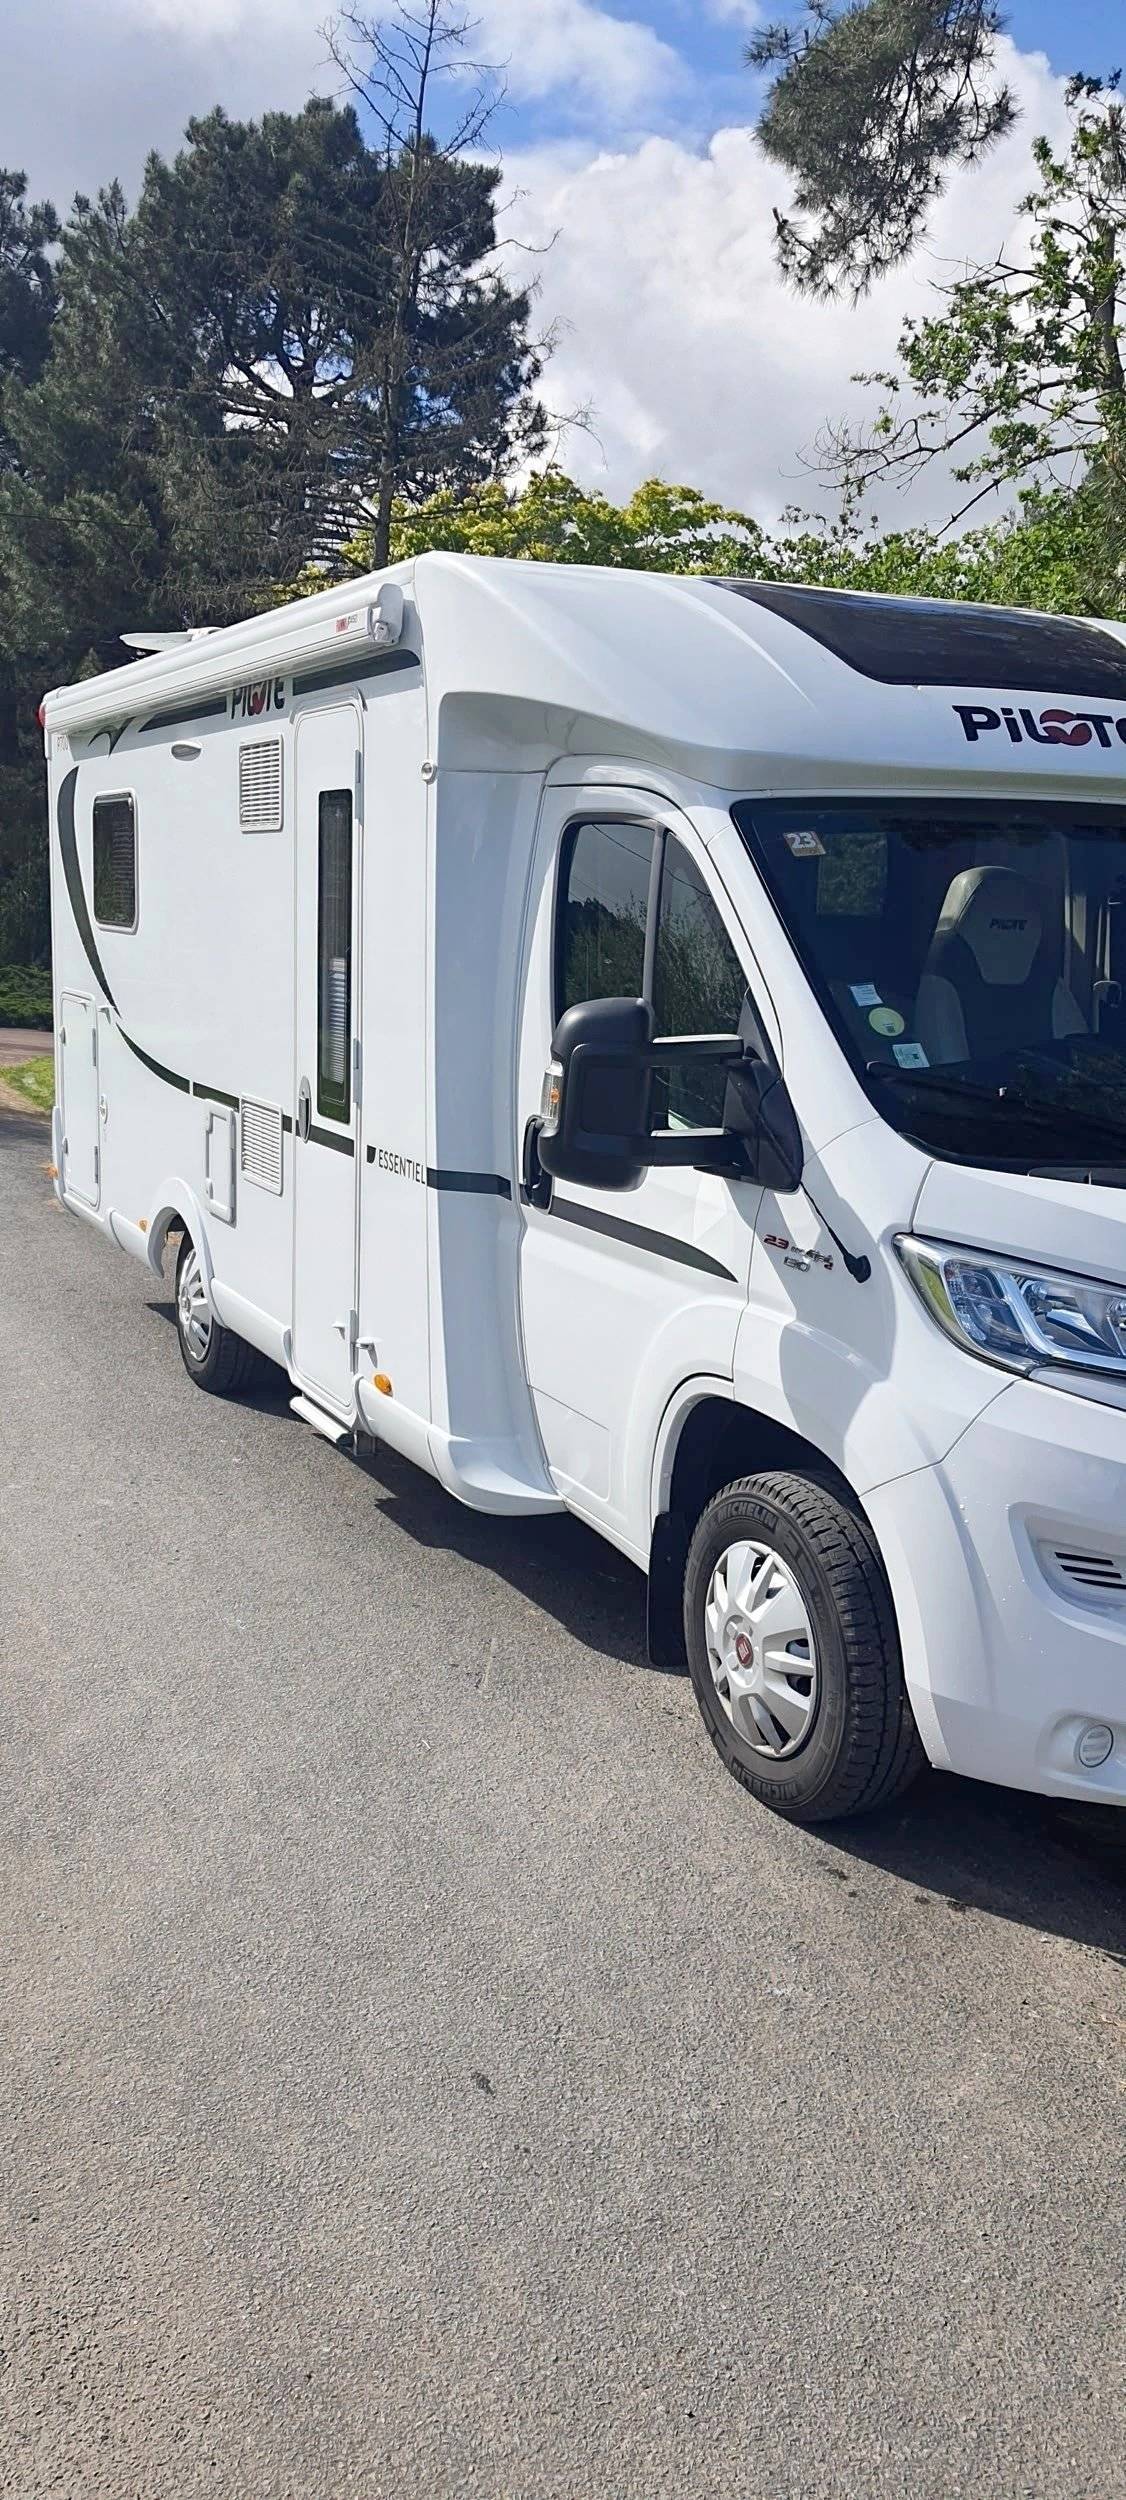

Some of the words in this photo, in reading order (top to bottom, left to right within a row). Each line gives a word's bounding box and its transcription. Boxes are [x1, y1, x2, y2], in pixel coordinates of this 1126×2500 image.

[784, 832, 816, 848] 23
[378, 1149, 426, 1185] ESSENTIEL
[716, 1499, 779, 1534] MICHELIN
